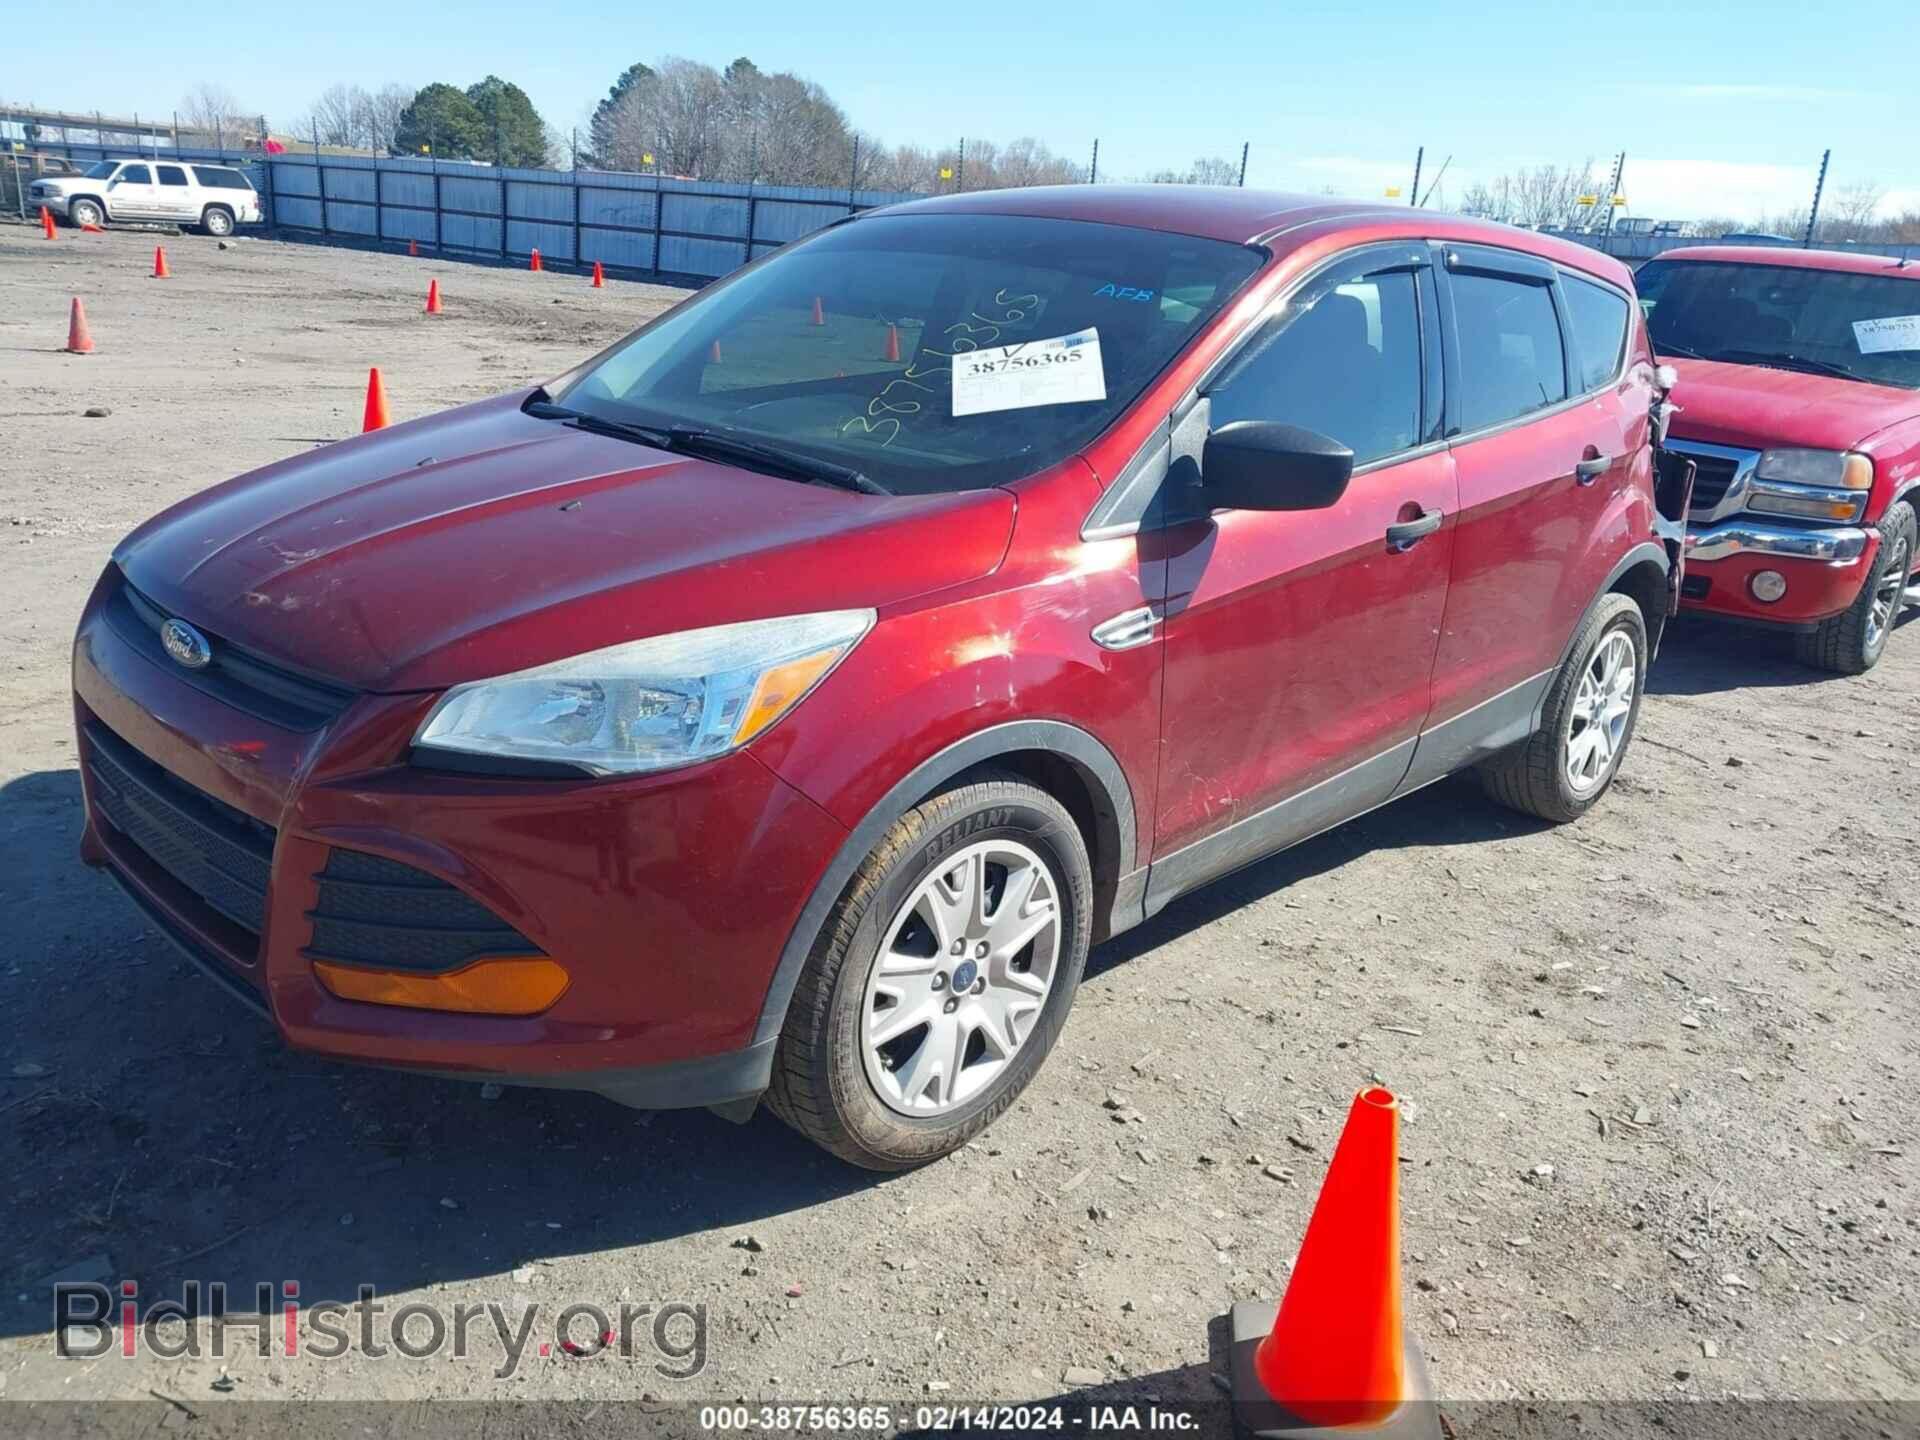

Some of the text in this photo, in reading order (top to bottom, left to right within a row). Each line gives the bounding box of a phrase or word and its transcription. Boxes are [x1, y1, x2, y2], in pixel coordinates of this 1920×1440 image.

[967, 349, 1084, 376] 38756365
[165, 625, 194, 659] Ford
[925, 806, 1017, 860] RELIANT
